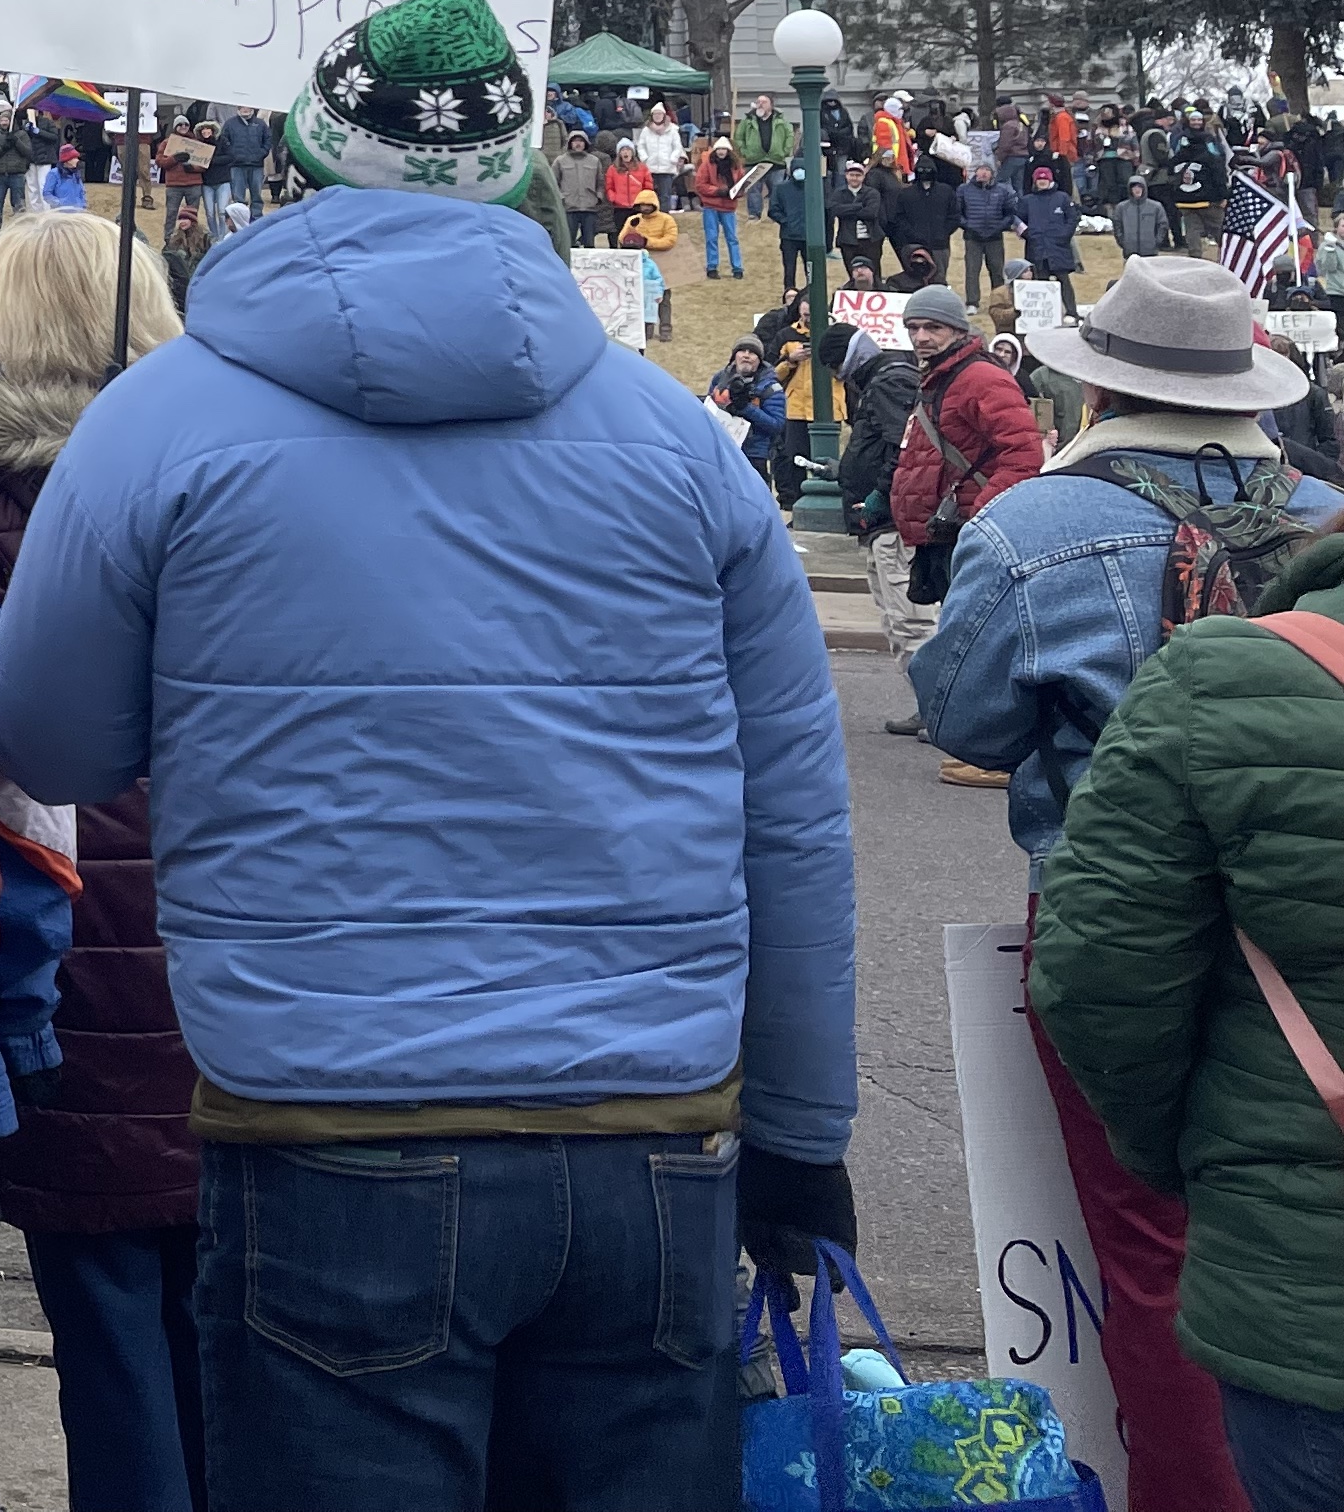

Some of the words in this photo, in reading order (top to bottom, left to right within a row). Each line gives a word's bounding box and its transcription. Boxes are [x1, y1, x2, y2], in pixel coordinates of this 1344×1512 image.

[839, 291, 887, 312] NO
[1268, 313, 1318, 329] YEET
[1284, 329, 1312, 341] THE
